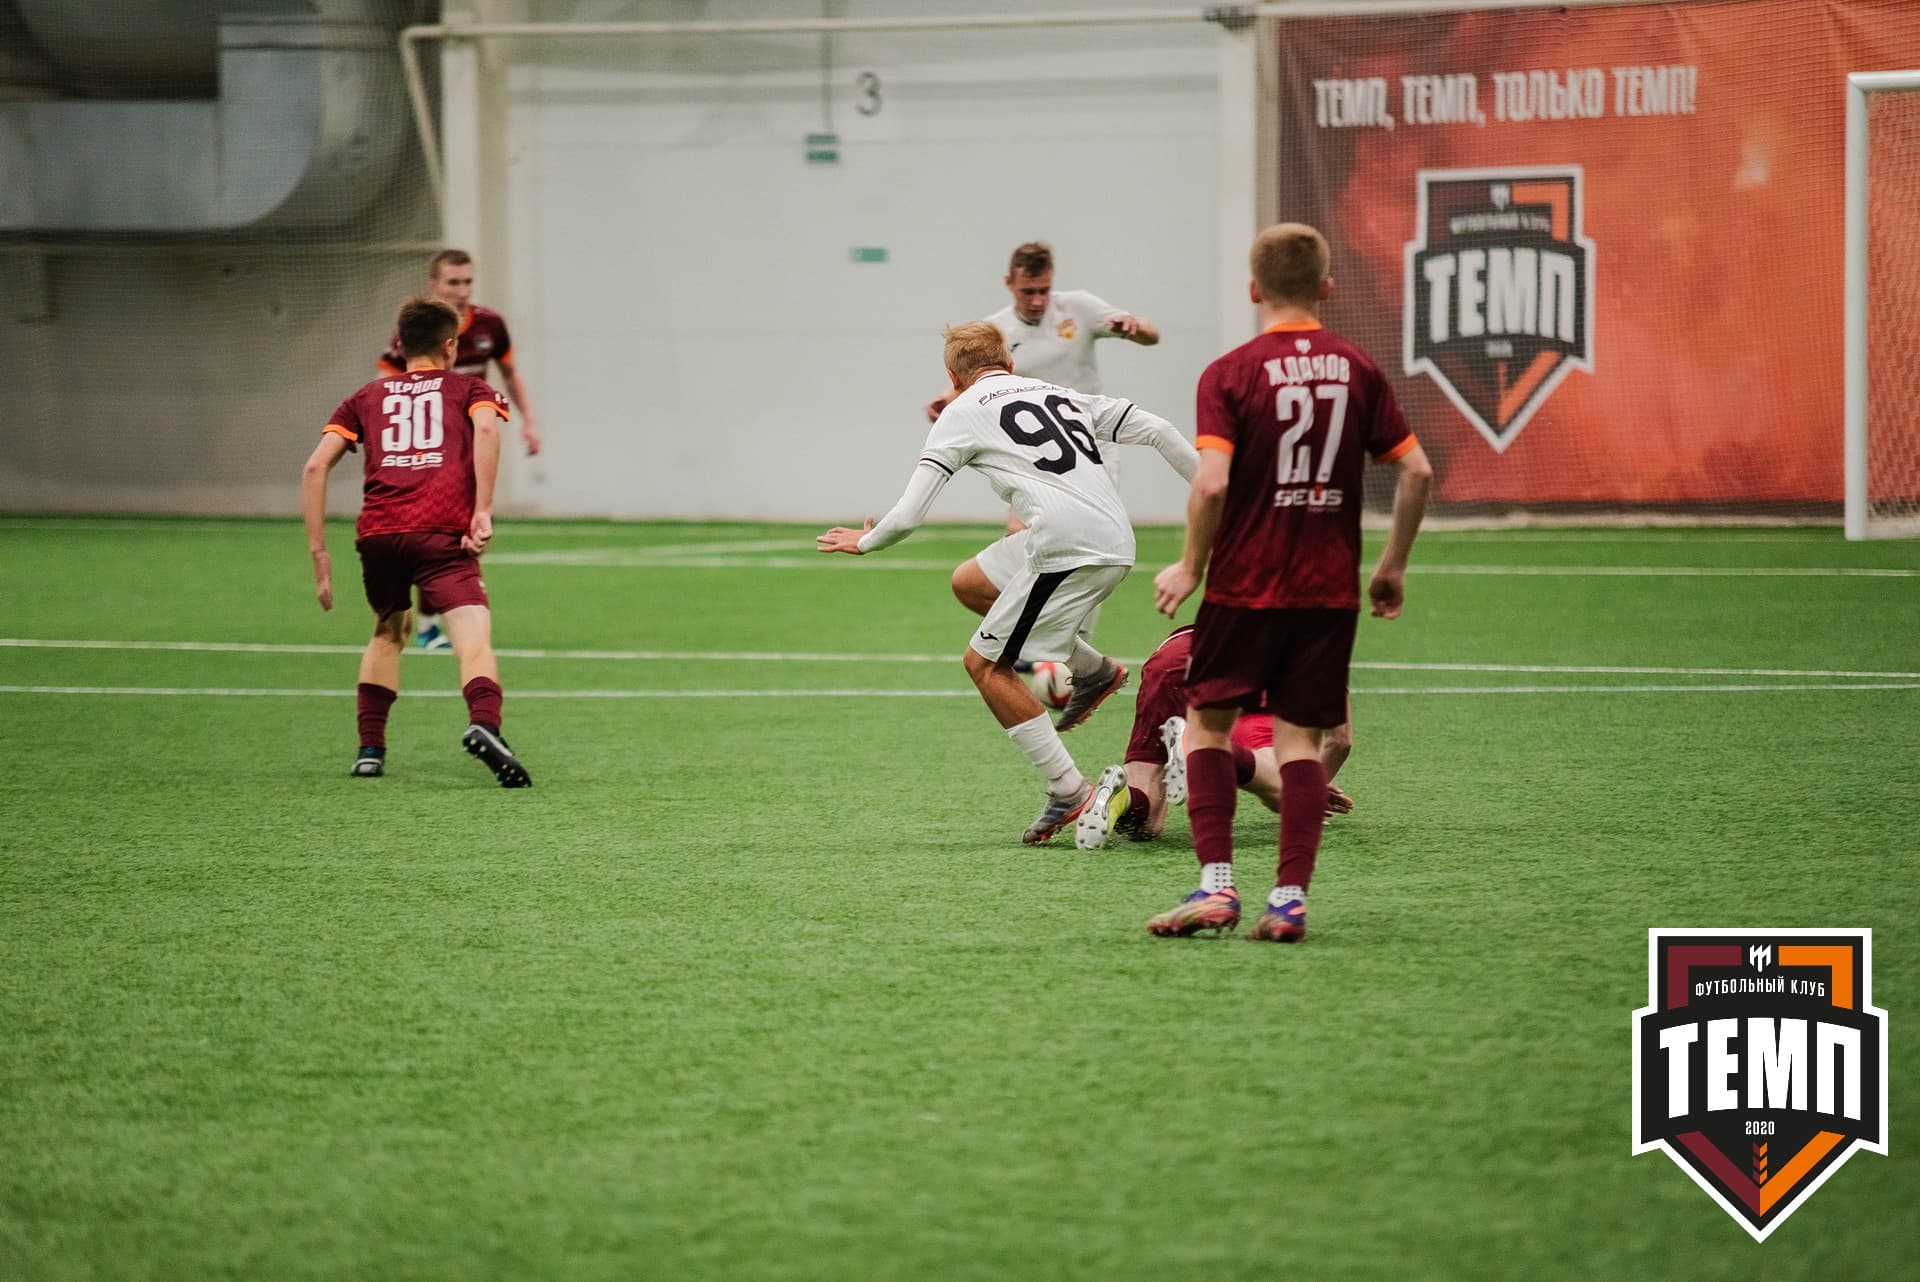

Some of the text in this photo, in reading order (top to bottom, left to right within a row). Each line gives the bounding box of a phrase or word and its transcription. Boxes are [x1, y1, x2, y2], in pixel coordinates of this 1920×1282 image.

[855, 70, 883, 117] 3
[1314, 64, 1697, 131] ТЕМП, ТЕМП, ТОЛЬКО ТЕМП!
[1423, 247, 1576, 344] ТЕМП
[1263, 353, 1350, 386] ЖДАНОВ
[381, 390, 444, 452] 30
[999, 394, 1103, 475] 96
[1275, 384, 1349, 484] 27
